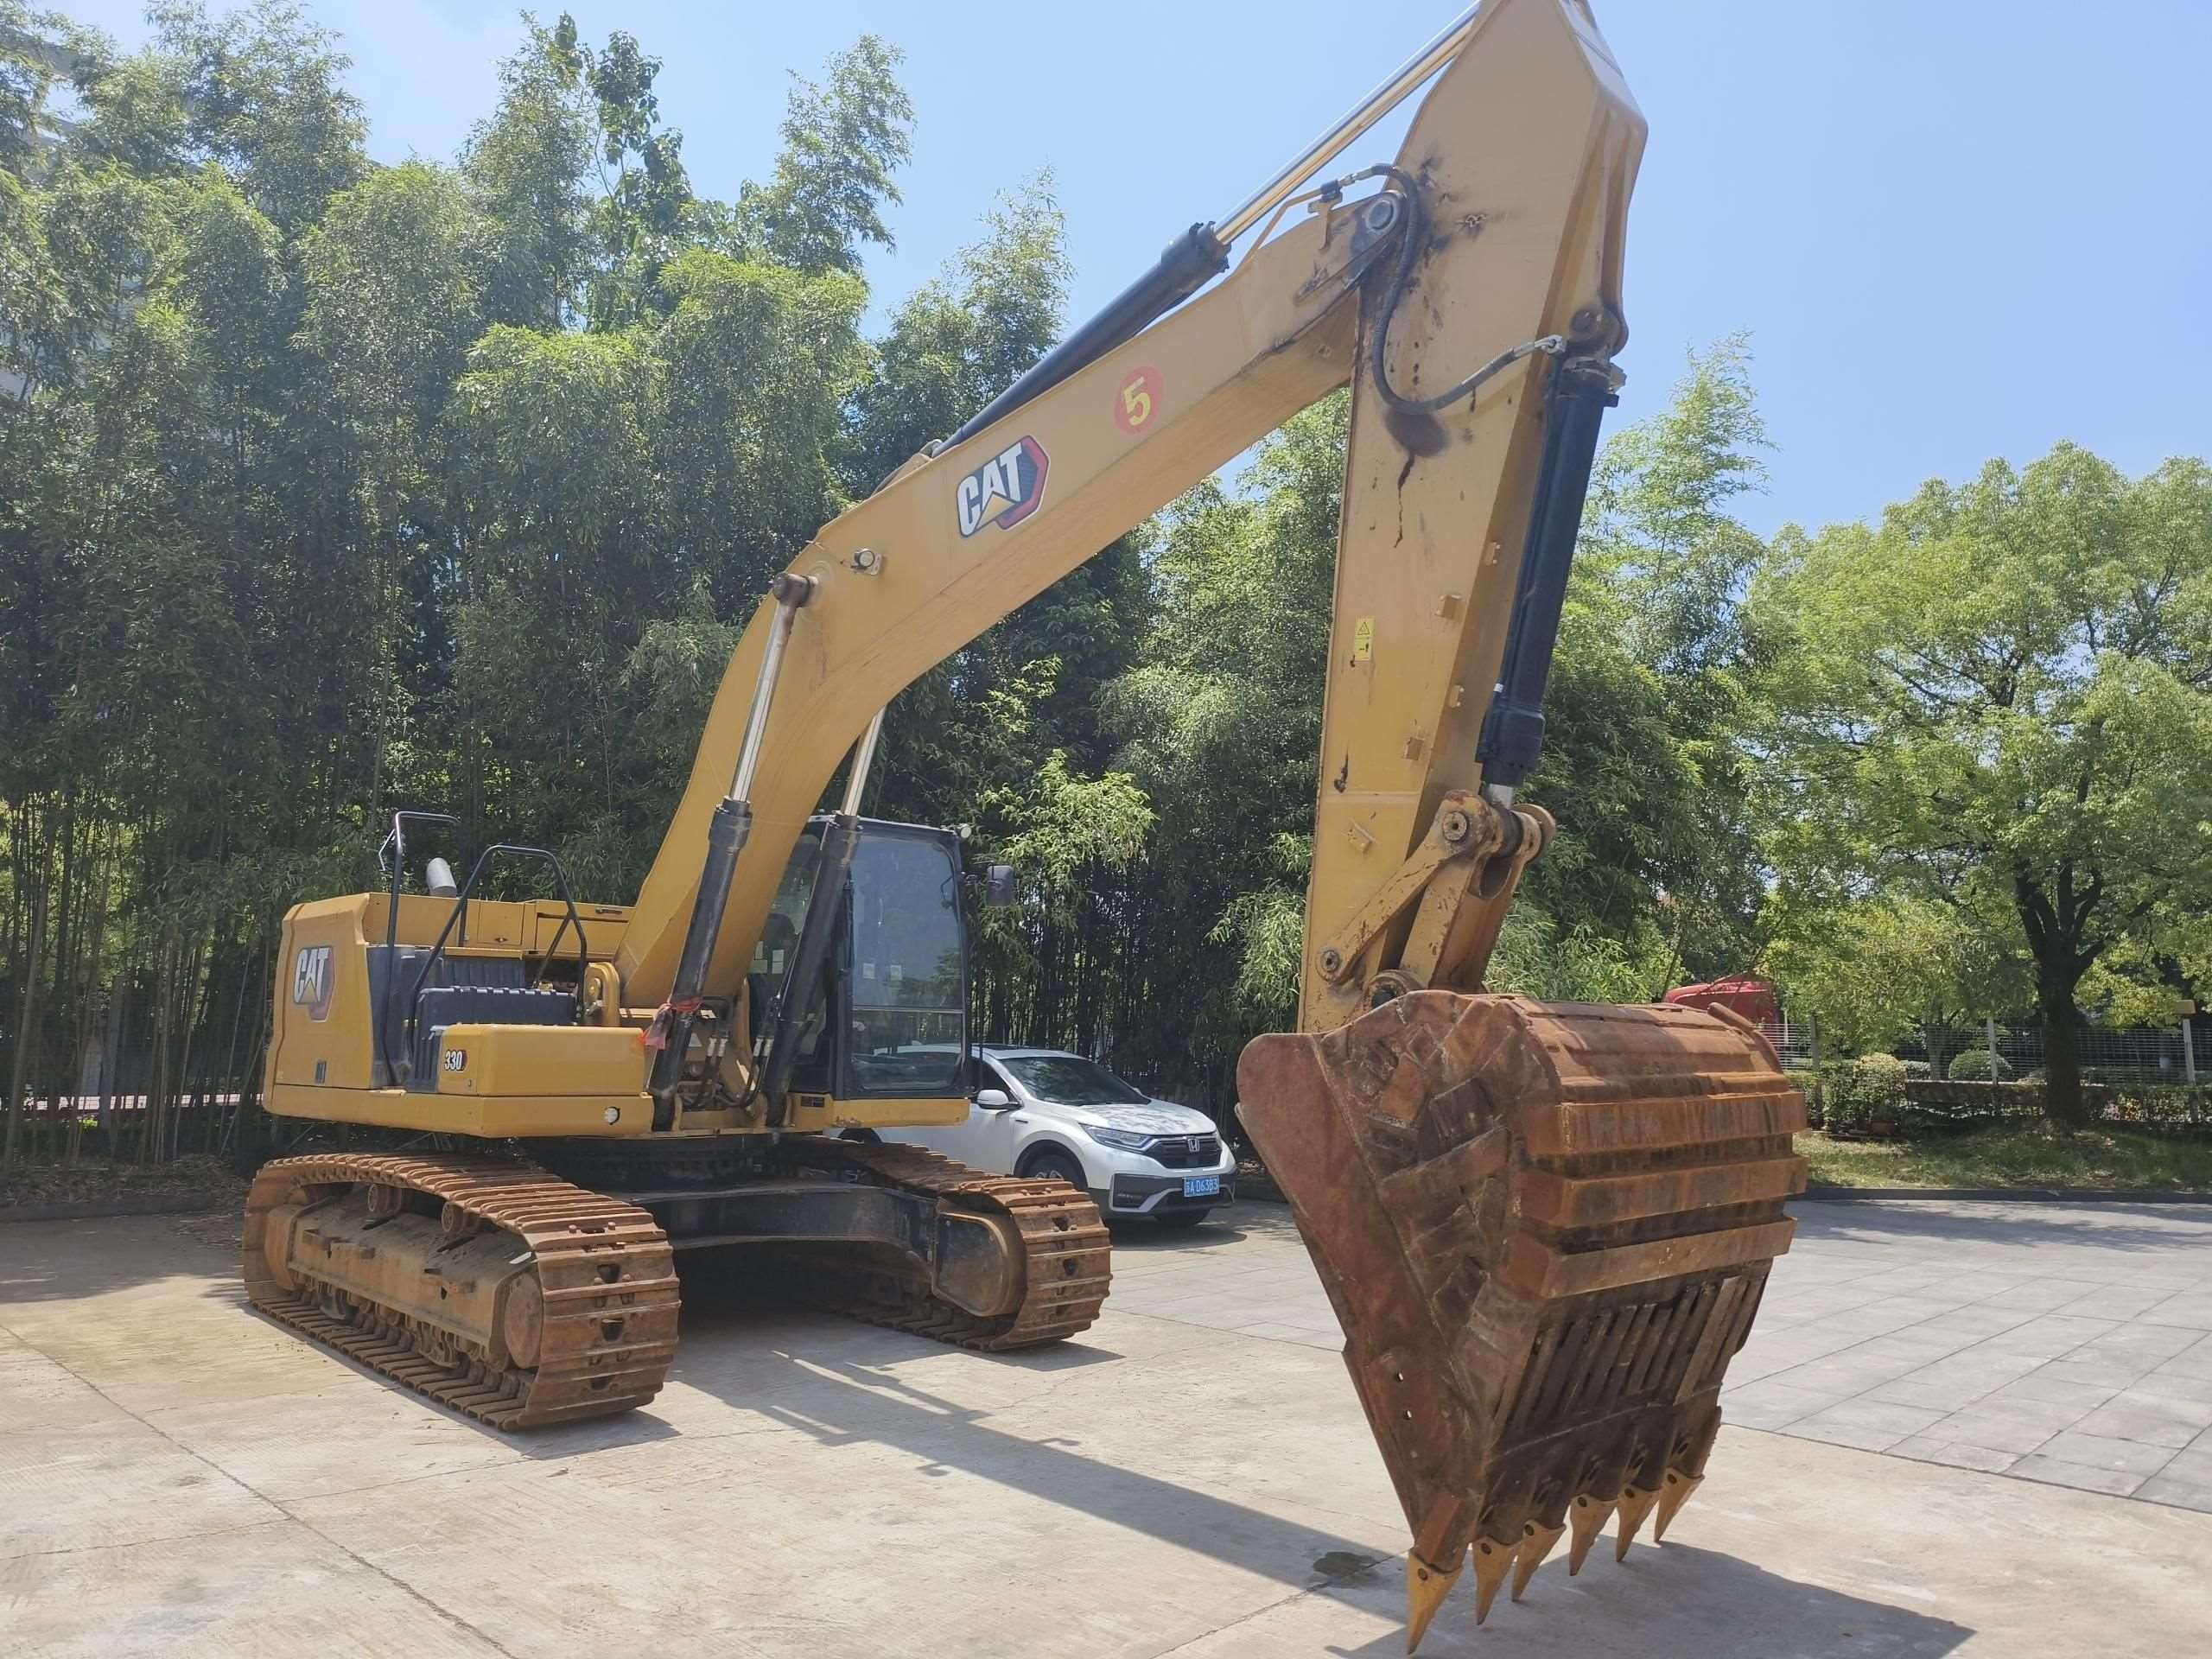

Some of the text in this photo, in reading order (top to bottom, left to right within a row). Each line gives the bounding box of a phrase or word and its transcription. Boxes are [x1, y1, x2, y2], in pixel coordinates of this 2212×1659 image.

[1124, 376, 1151, 426] 5
[957, 442, 1022, 537] CAT
[295, 947, 329, 1003] CAT
[444, 1050, 463, 1071] 330
